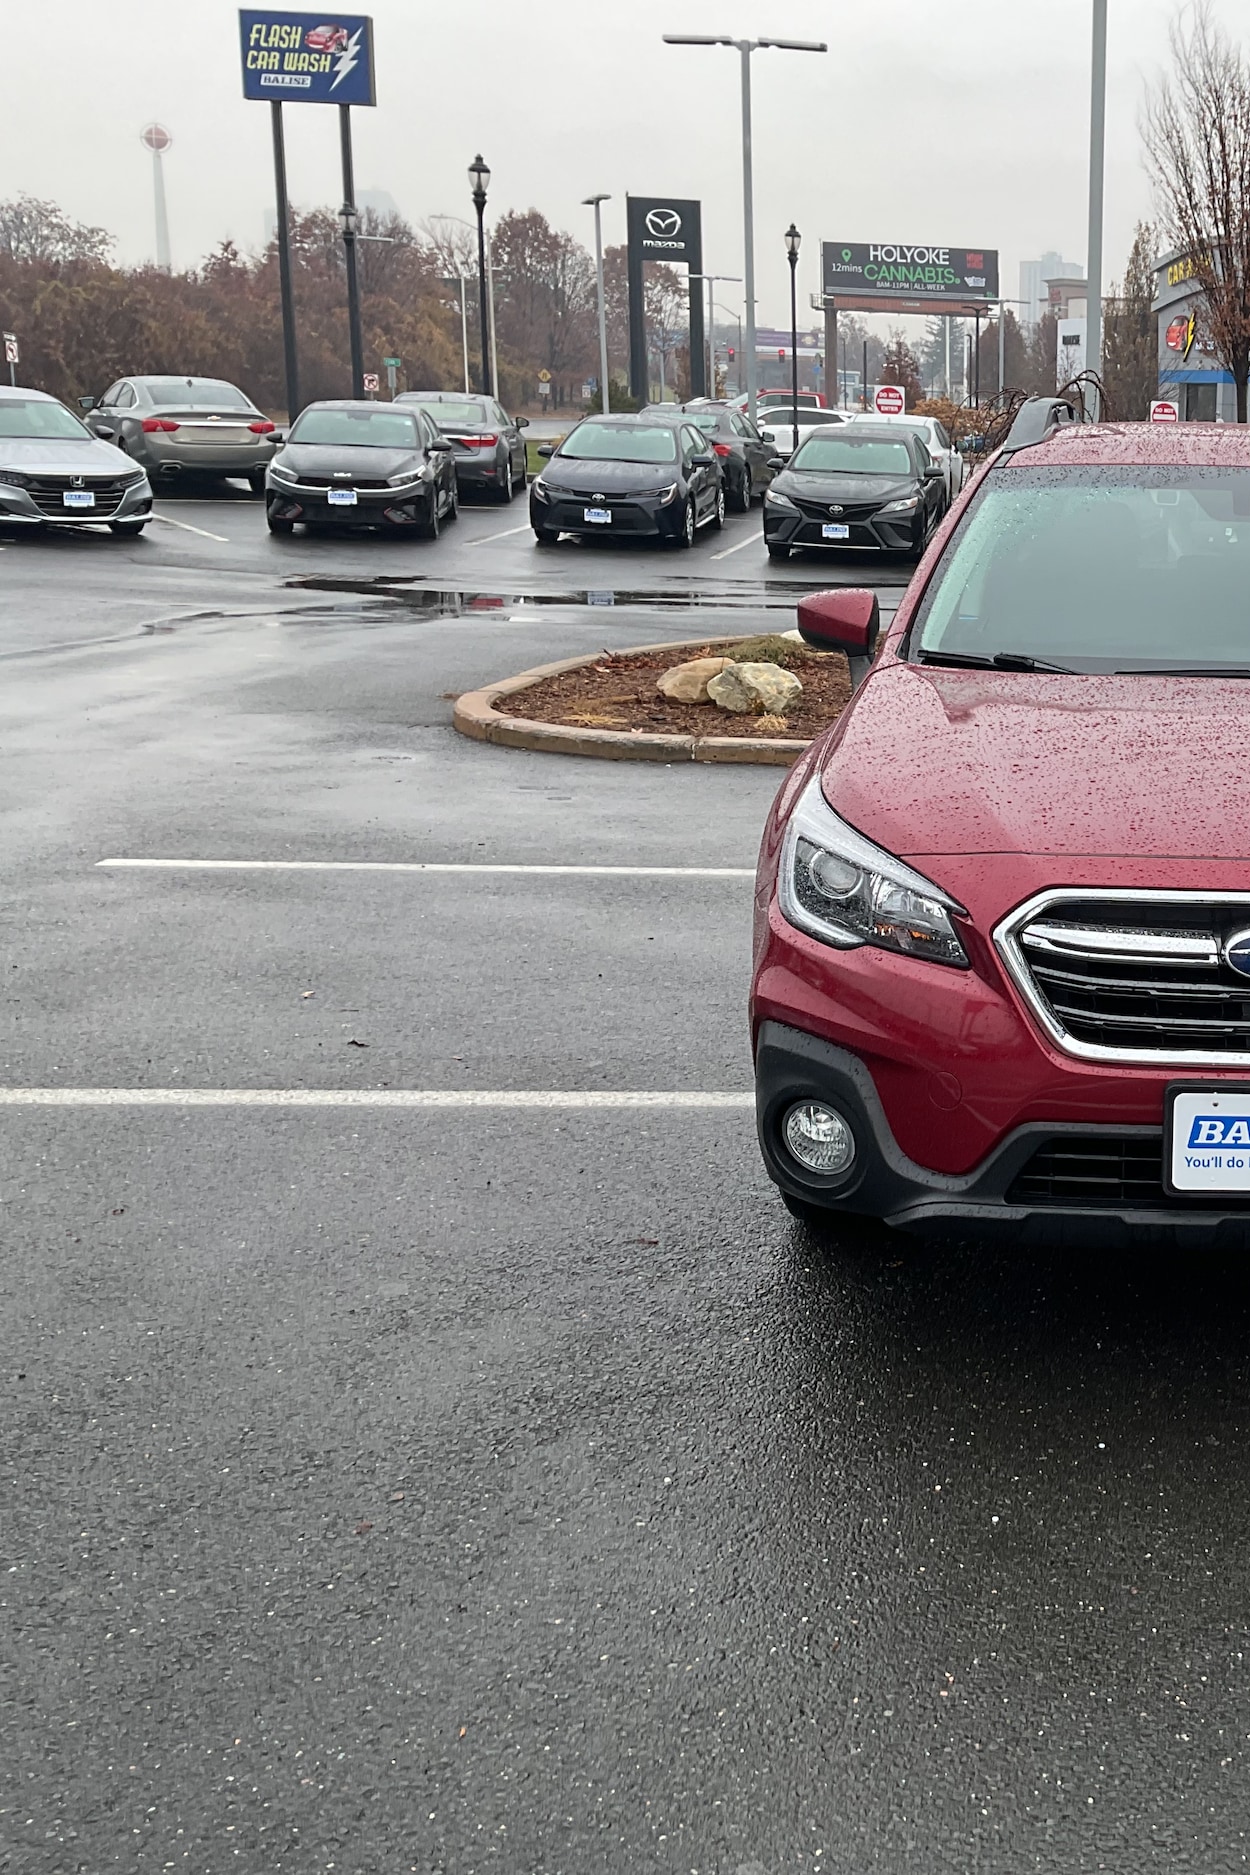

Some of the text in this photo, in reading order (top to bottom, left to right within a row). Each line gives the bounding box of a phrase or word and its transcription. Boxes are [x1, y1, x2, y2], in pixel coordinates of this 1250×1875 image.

[249, 24, 302, 48] FLASH
[246, 50, 331, 72] CAR WASH
[263, 76, 308, 85] BALISE
[642, 239, 685, 250] mazda
[869, 245, 950, 265] HOLYOKE
[831, 262, 863, 274] 12mins
[1168, 262, 1184, 286] CAR
[1184, 1156, 1222, 1168] You'll
[1226, 1157, 1244, 1168] do
